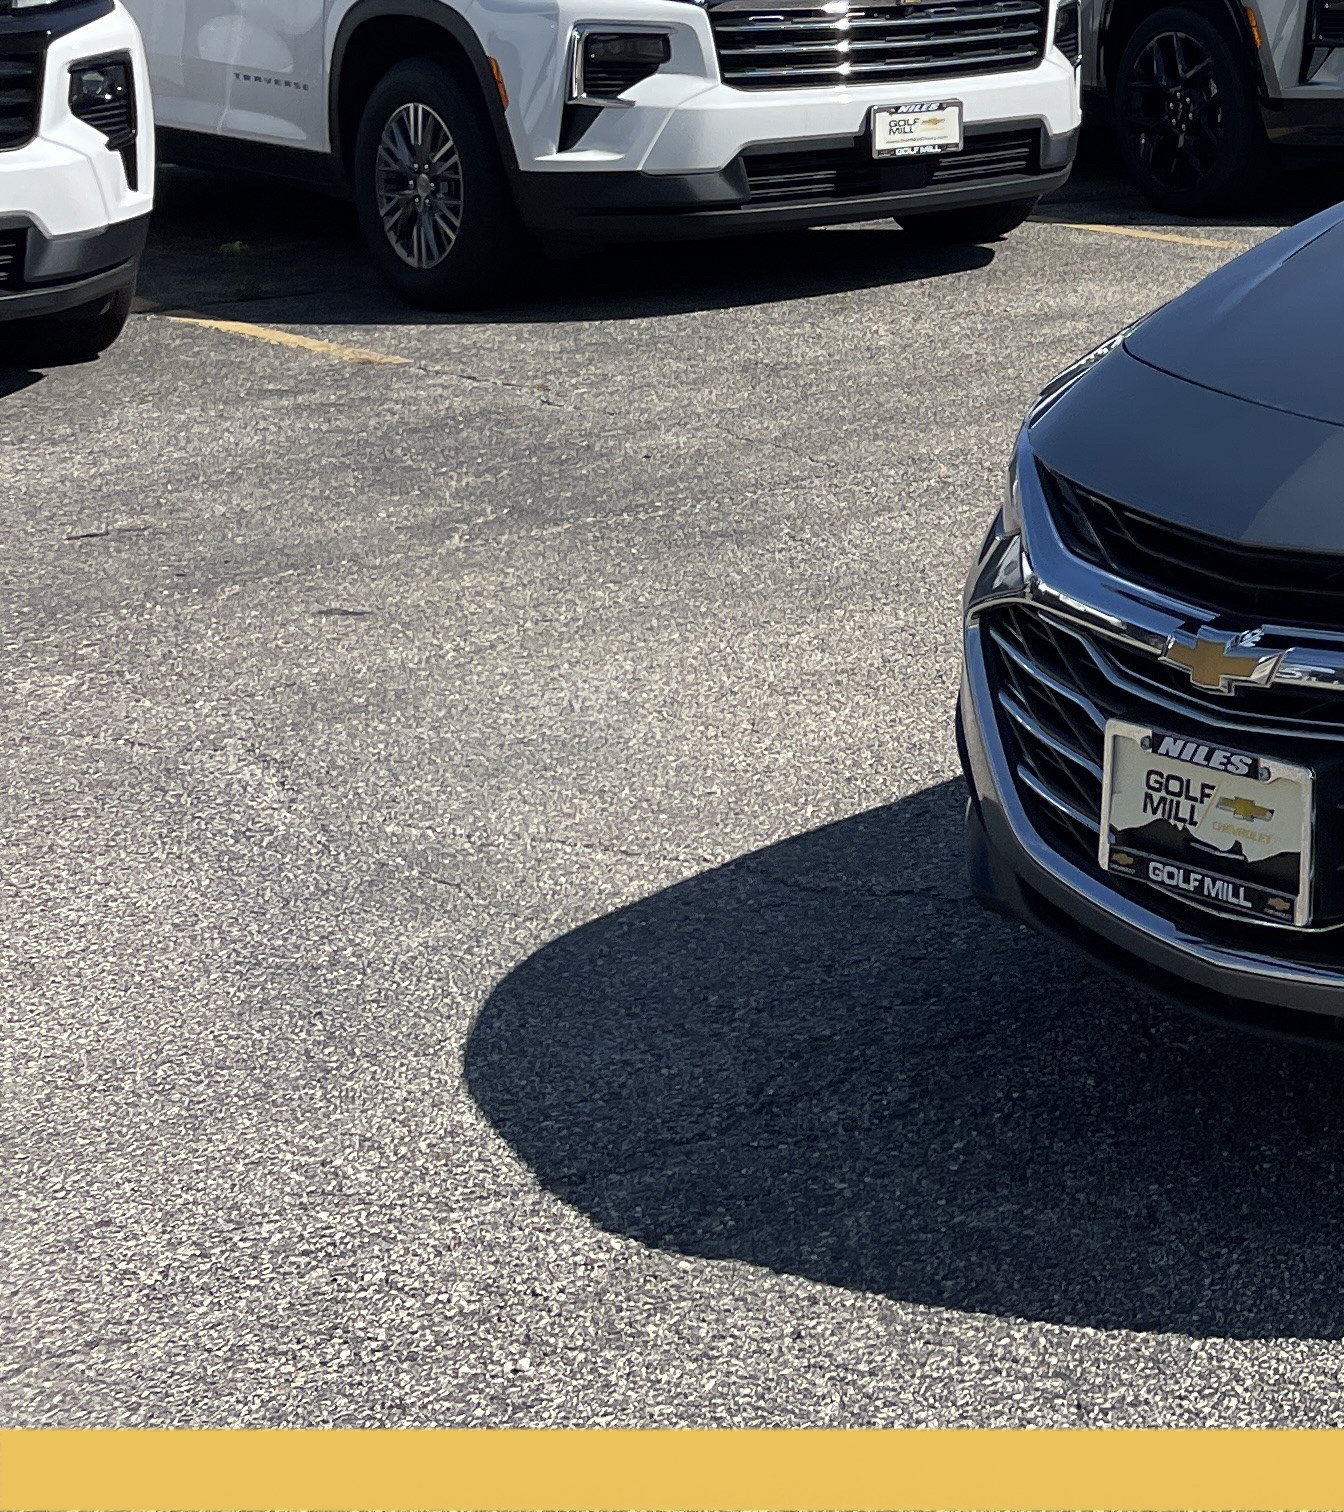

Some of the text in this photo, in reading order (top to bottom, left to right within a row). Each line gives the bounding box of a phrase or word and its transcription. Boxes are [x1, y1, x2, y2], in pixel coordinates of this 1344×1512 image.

[888, 117, 920, 128] GOLF
[888, 126, 914, 136] MILL
[1157, 736, 1253, 775] NILES
[1145, 769, 1217, 804] GOLF
[1142, 791, 1199, 828] MILL
[1148, 861, 1253, 908] GOLF MILL
